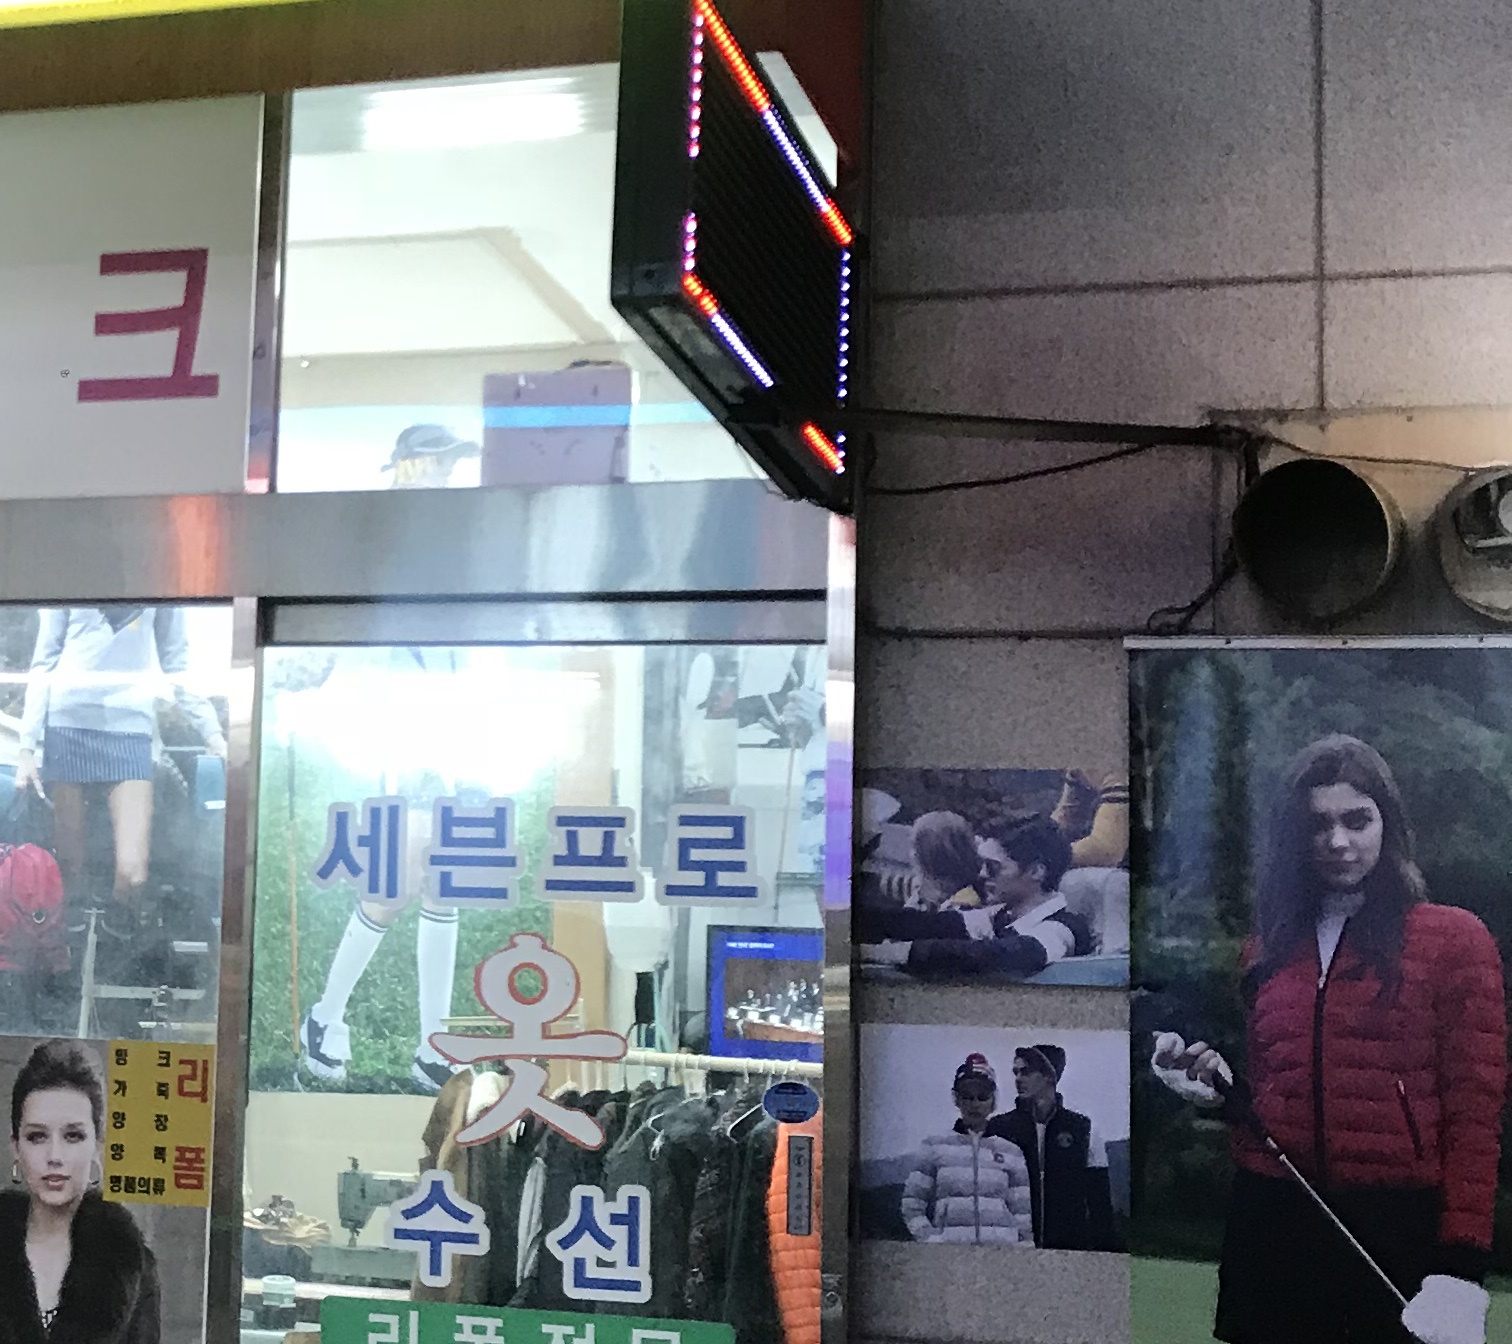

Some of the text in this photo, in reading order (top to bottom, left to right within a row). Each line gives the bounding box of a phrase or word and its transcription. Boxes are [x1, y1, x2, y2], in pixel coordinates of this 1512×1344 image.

[312, 800, 764, 904] 세븐프로
[429, 933, 628, 1150] 옷
[390, 1176, 646, 1297] 수선
